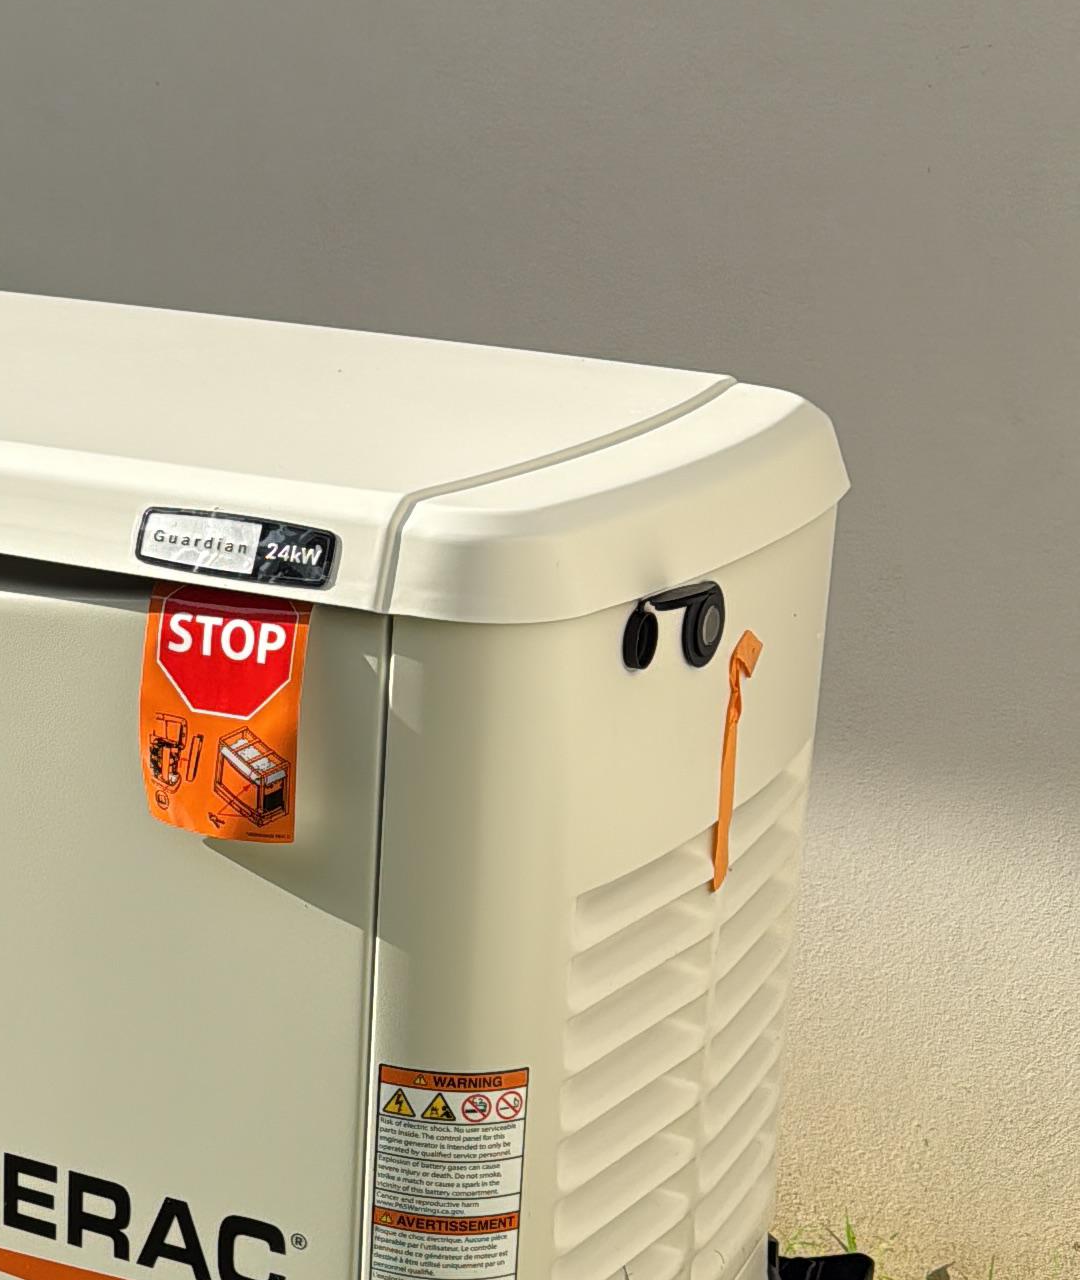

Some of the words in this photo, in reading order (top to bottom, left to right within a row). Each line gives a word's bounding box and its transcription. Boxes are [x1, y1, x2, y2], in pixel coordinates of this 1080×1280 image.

[153, 529, 248, 555] Guardian
[265, 543, 323, 567] 24kW
[168, 611, 287, 664] STOP
[433, 1075, 503, 1089] WARNING
[396, 1214, 516, 1232] AVERTISSEMENT
